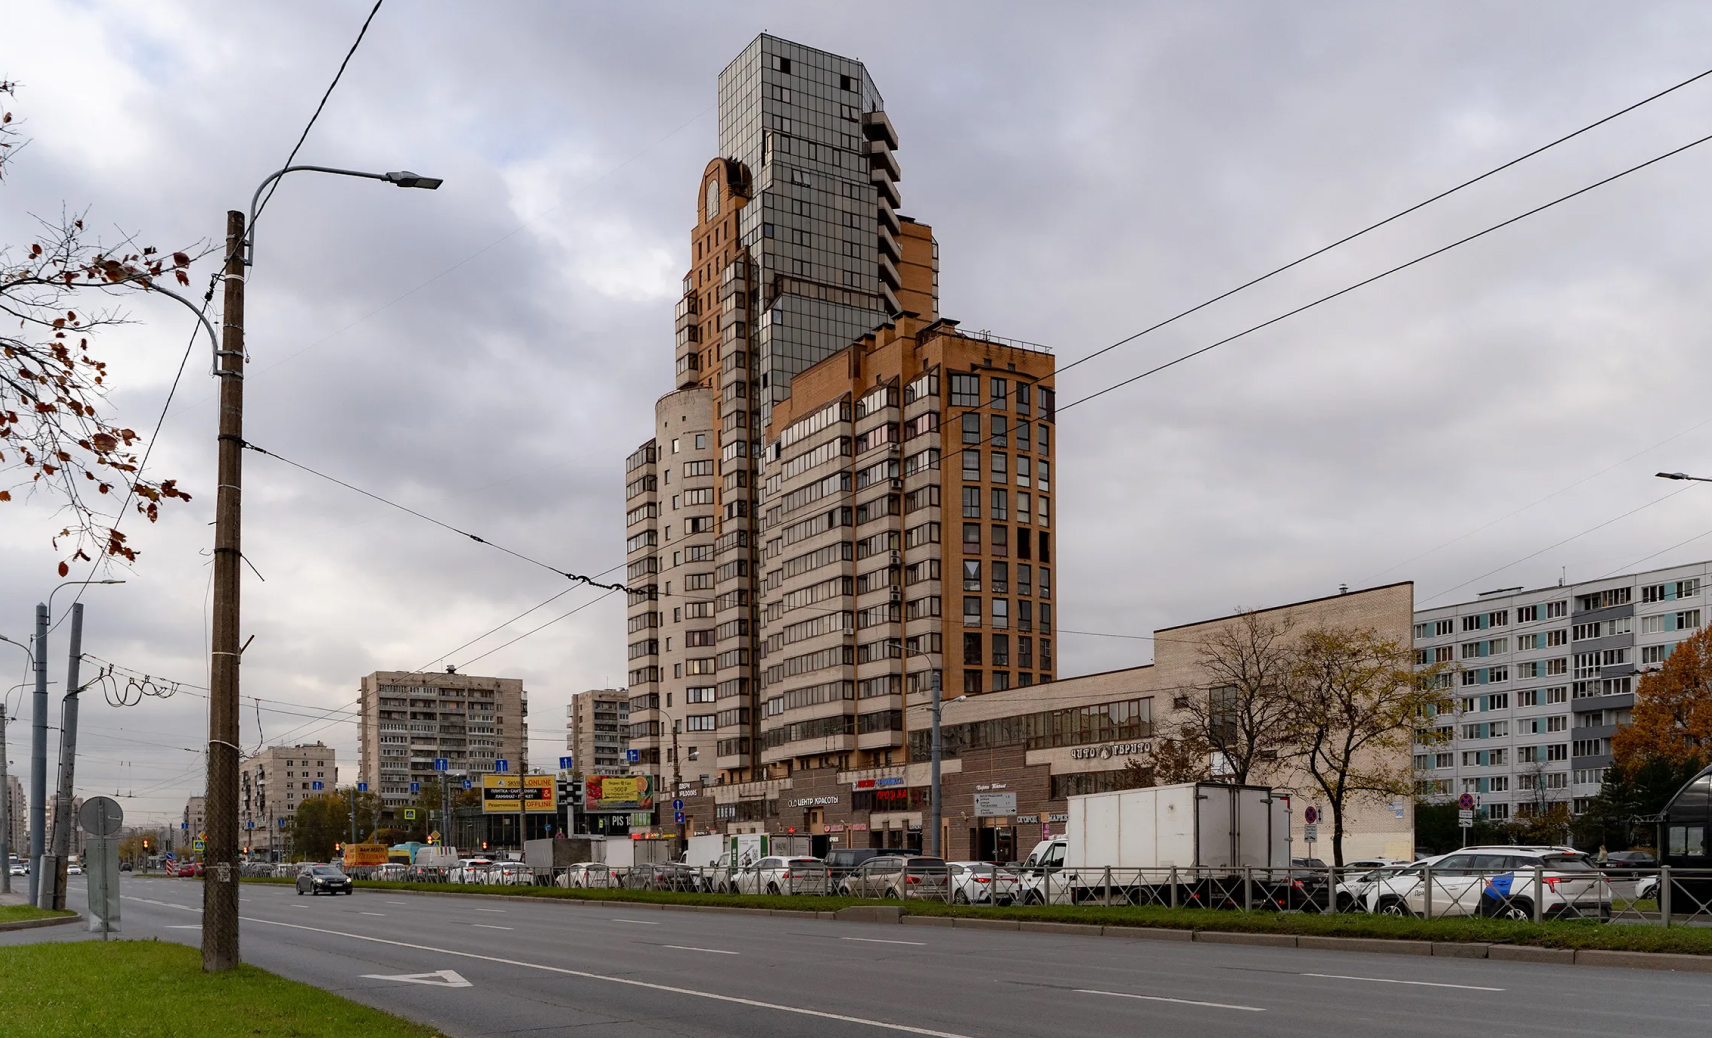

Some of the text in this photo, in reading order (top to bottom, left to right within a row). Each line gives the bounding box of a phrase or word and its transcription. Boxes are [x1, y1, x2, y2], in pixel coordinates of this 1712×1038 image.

[798, 796, 838, 806] ЦЕНТР КРАСОТЫ
[612, 816, 623, 826] PIS
